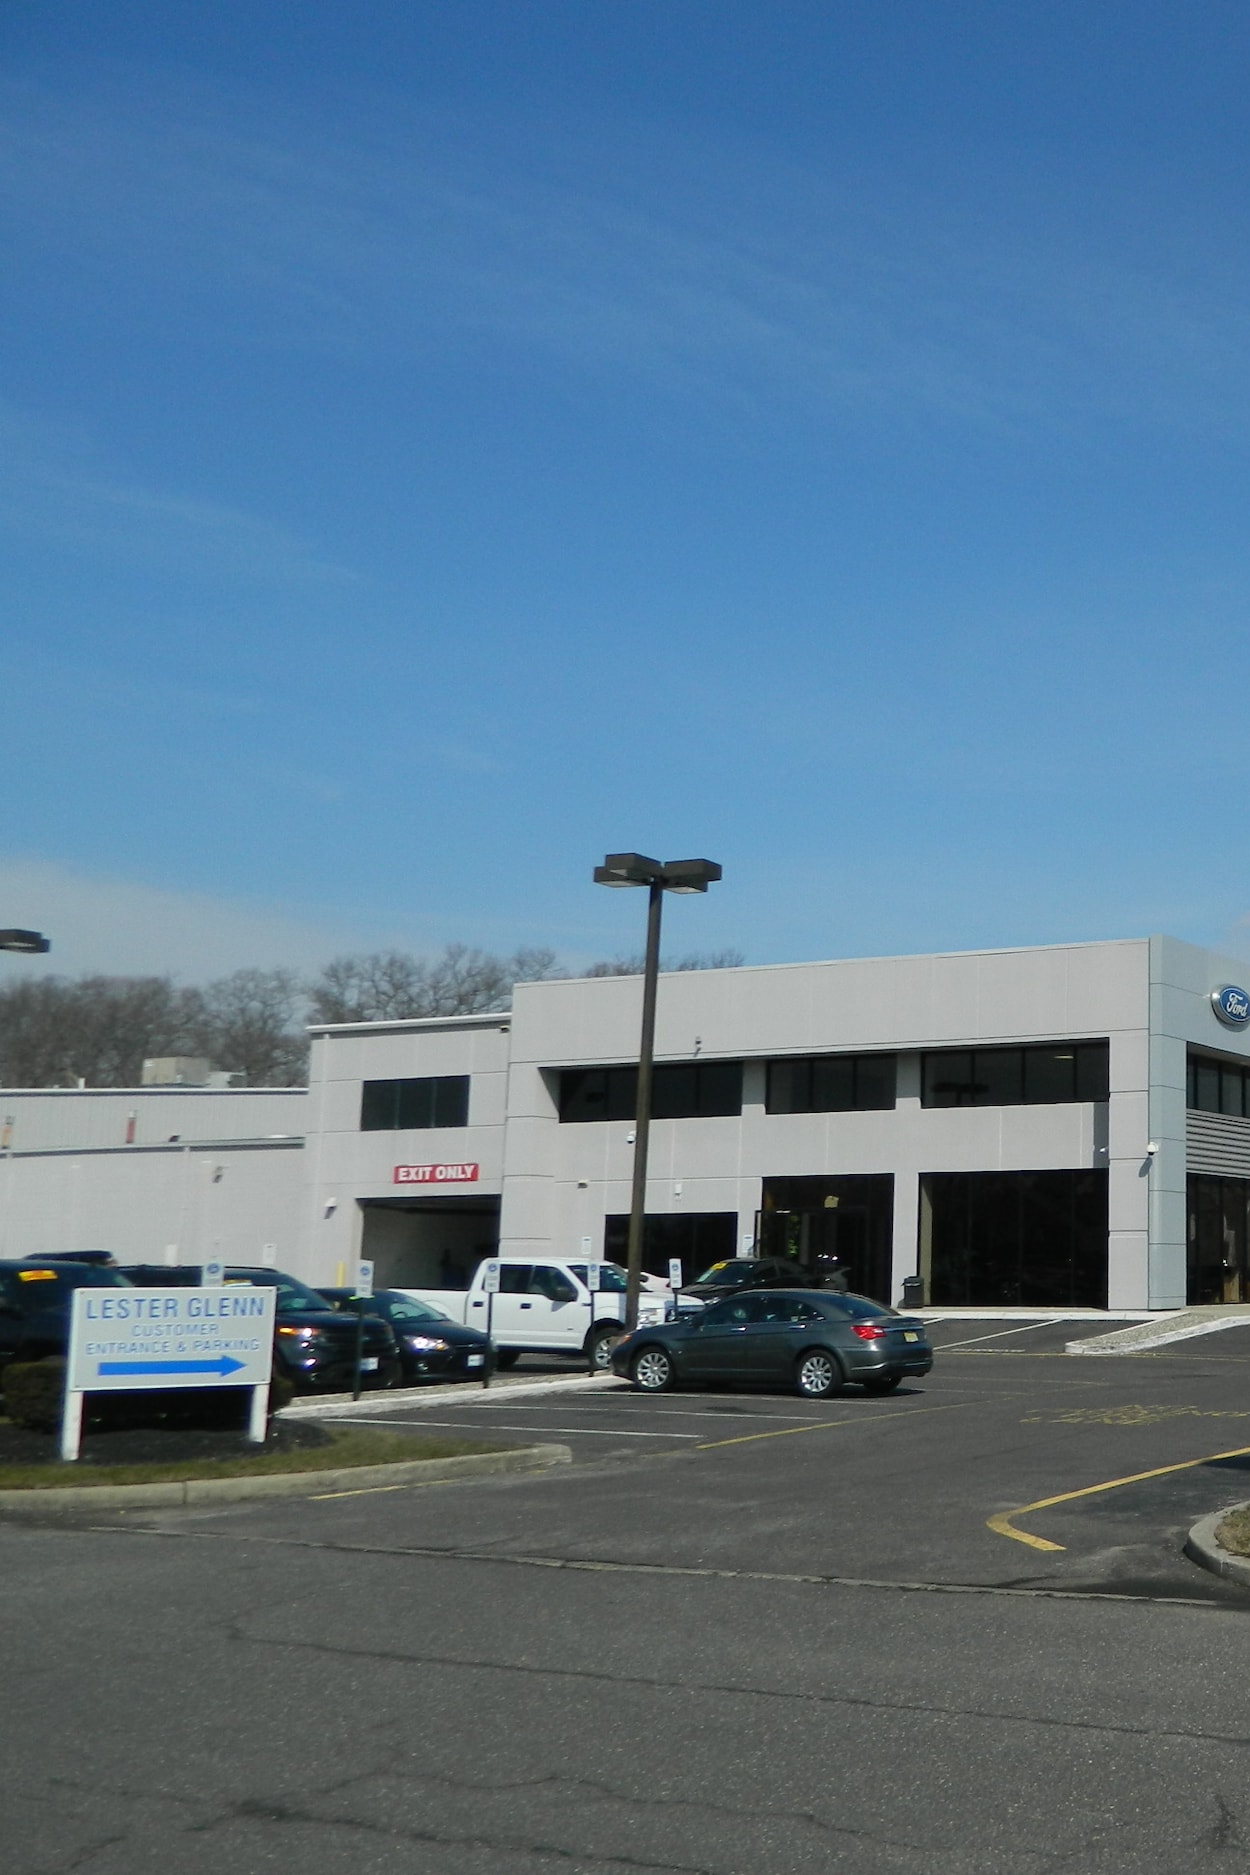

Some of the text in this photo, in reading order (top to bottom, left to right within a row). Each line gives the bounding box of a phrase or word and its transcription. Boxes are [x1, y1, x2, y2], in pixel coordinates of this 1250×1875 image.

[1226, 992, 1248, 1017] Ford
[398, 1164, 475, 1181] EXIT ONLY
[86, 1297, 264, 1319] LESTER GLENN
[131, 1323, 219, 1337] CUSTOMER
[85, 1338, 260, 1355] ENTRANCE & PARKING
